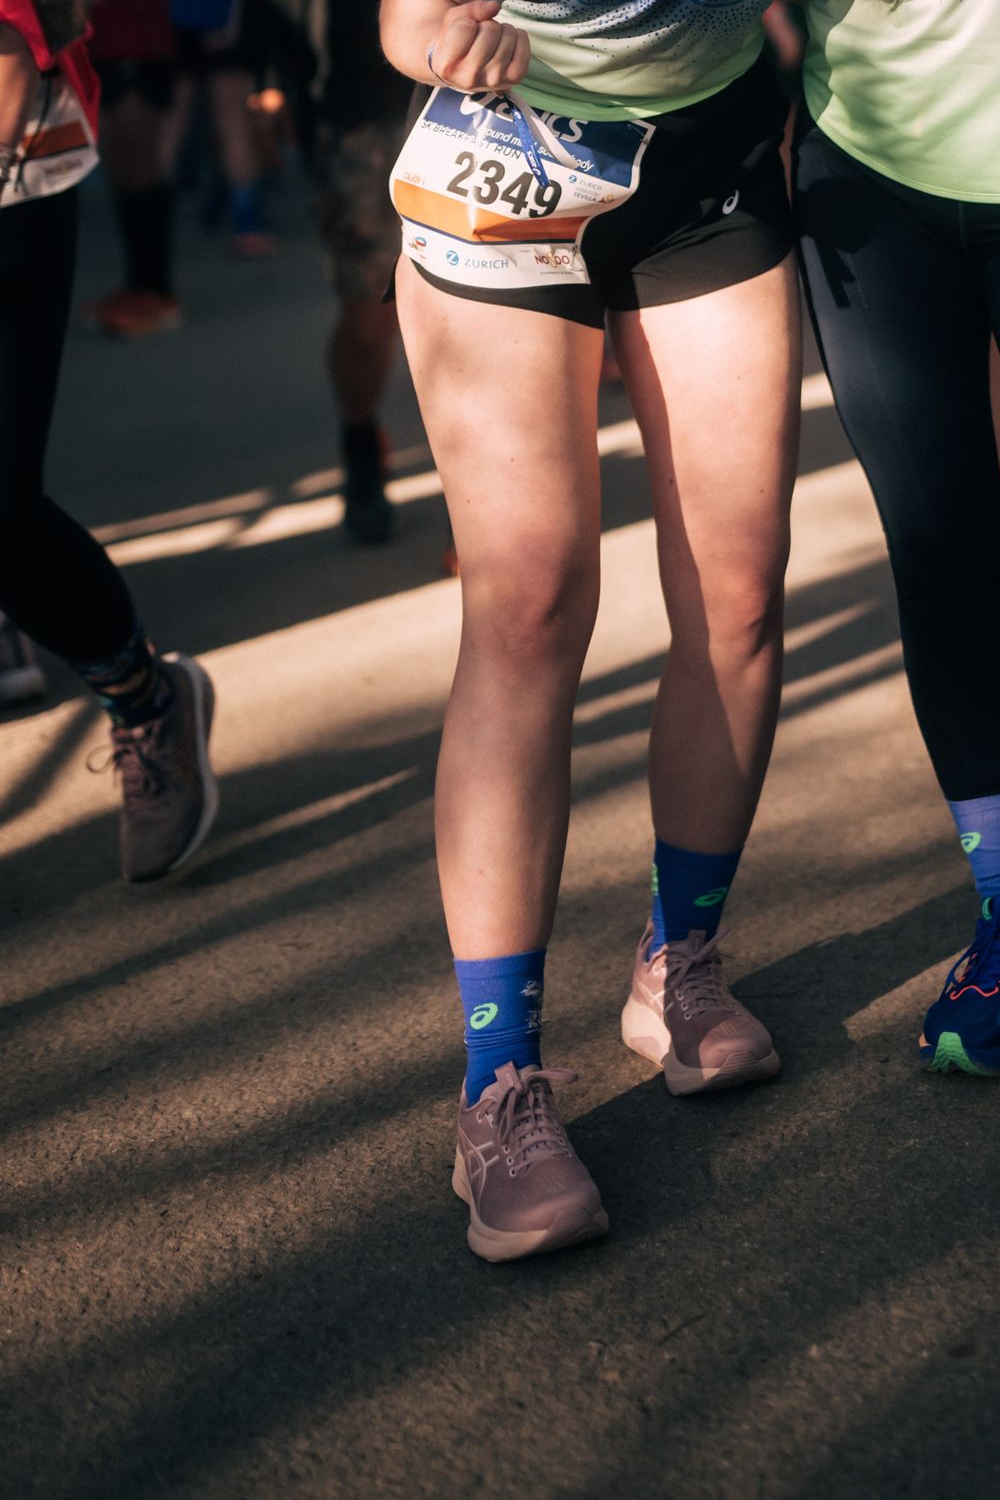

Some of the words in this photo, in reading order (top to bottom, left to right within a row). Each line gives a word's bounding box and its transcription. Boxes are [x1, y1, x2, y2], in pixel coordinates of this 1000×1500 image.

[494, 144, 522, 160] RUN
[446, 150, 563, 219] 2349
[464, 258, 509, 270] ZURICH
